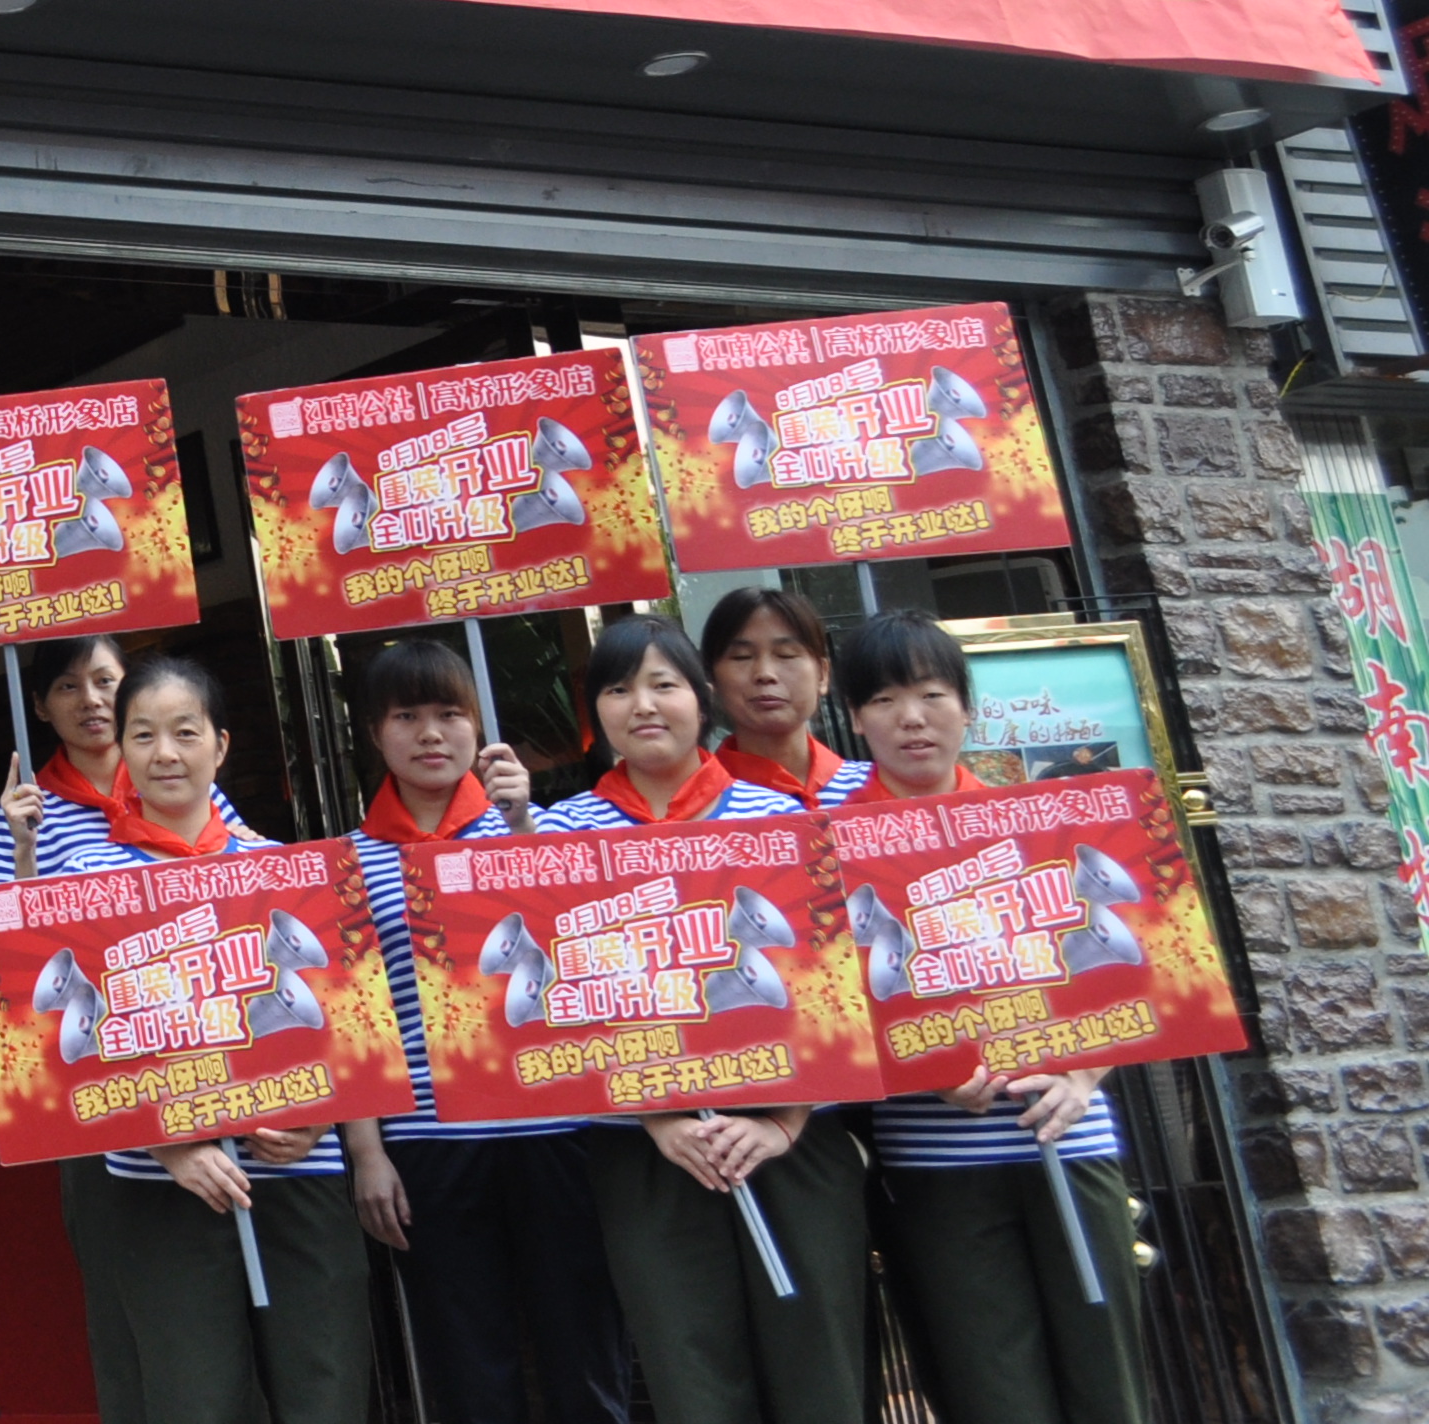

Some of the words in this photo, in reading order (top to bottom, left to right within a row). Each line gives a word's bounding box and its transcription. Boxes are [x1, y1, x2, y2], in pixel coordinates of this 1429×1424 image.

[699, 329, 808, 364] 江南公社
[824, 317, 987, 359] 高桥形象店
[304, 386, 412, 425] 江南公社
[429, 364, 597, 414] 高桥形象店
[776, 358, 882, 409] 9月18号
[378, 413, 488, 469] 9月18号
[777, 384, 932, 449] 重装开业
[379, 436, 534, 510] 重装开业
[954, 785, 1130, 839] 高桥形象店
[23, 874, 139, 918] 江南公社
[158, 851, 328, 904] 高桥形象店
[474, 843, 595, 879] 江南公社
[615, 830, 799, 875] 高桥形象店
[907, 839, 1022, 905] 9月18号
[105, 904, 219, 970] 9月18号
[556, 877, 678, 936] 9月18号
[912, 867, 1080, 951] 重装开业
[107, 930, 270, 1014] 重装开业
[558, 906, 732, 981] 重装开业
